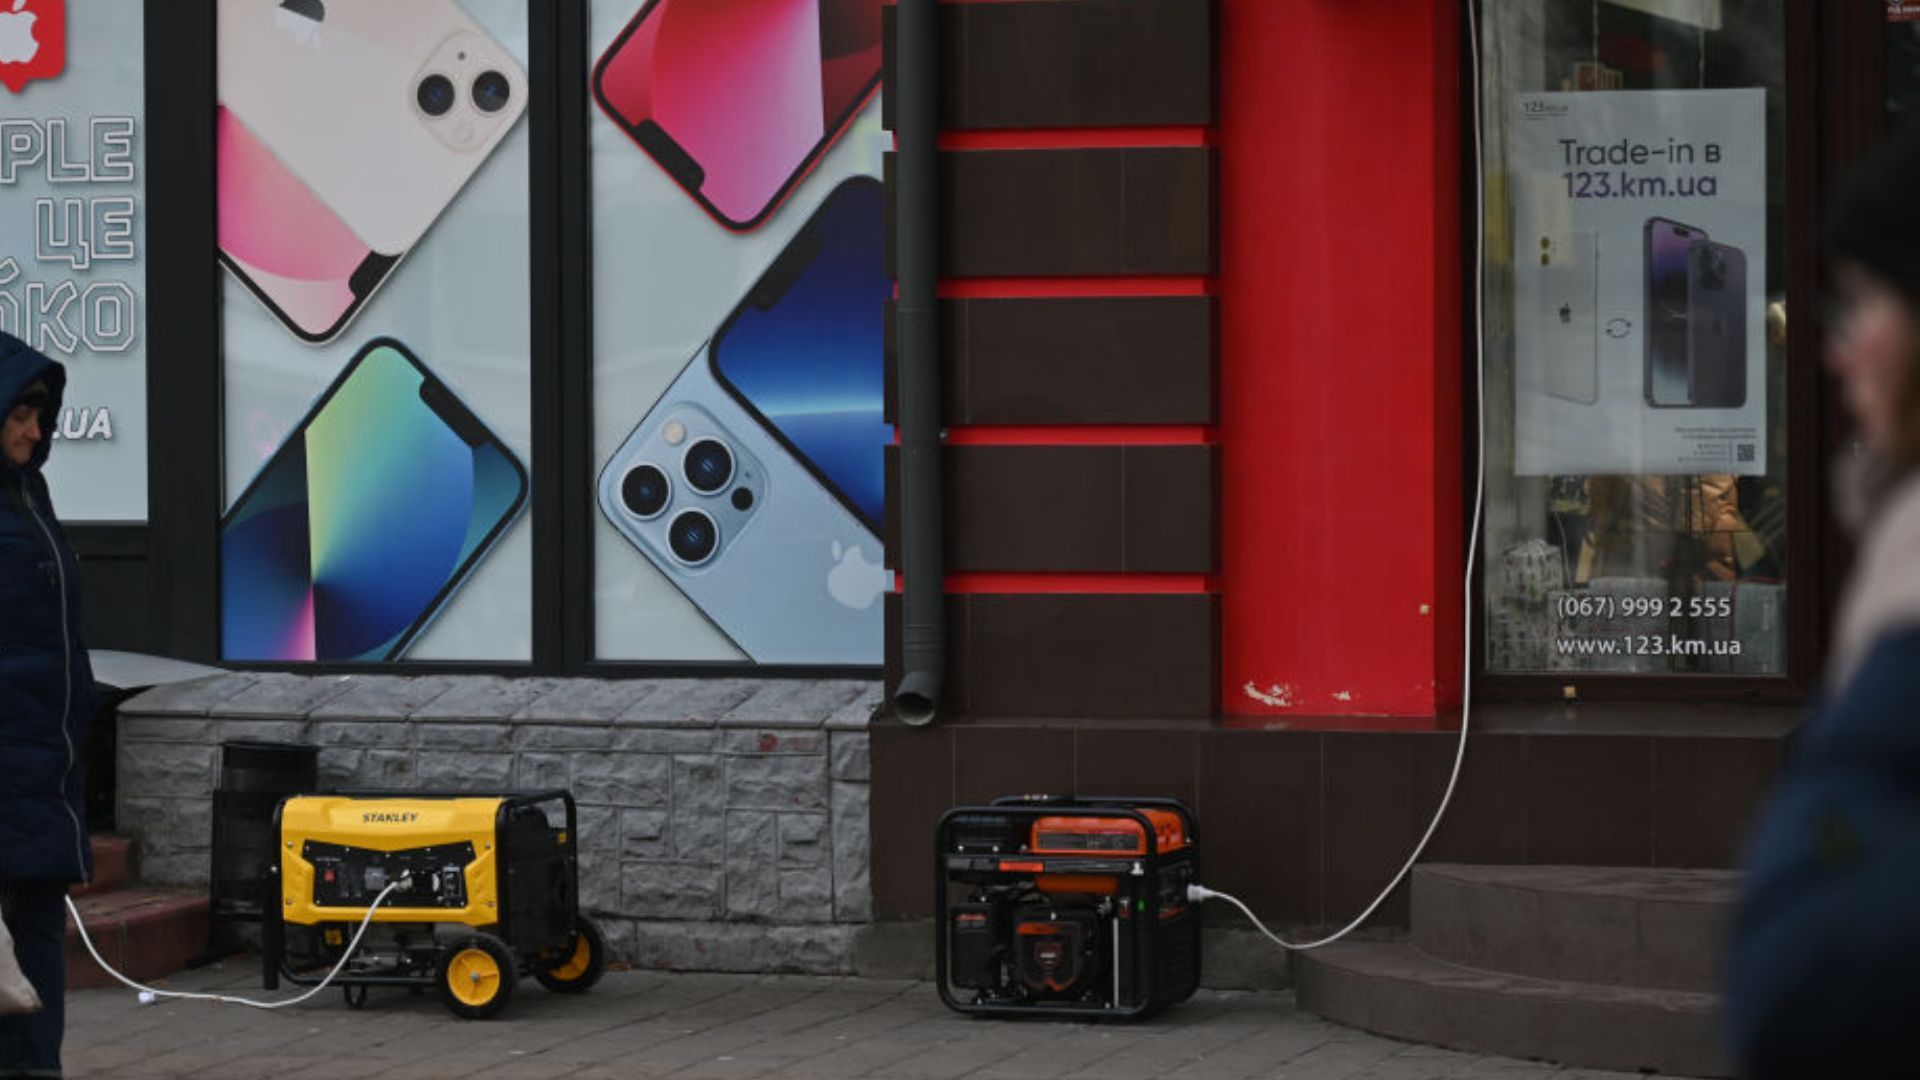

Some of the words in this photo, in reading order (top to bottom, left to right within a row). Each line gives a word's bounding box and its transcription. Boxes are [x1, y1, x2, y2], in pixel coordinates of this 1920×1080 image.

[1559, 138, 1694, 165] Trade-in
[1564, 172, 1717, 198] 123.km.ua
[36, 197, 134, 269] ЦЕ
[1558, 597, 1615, 619] (067)
[1621, 597, 1663, 617] 999
[1669, 598, 1683, 617] 2
[1689, 598, 1731, 617] 555
[1557, 634, 1741, 655] www.123.km.ua
[362, 812, 418, 824] STANLEY
